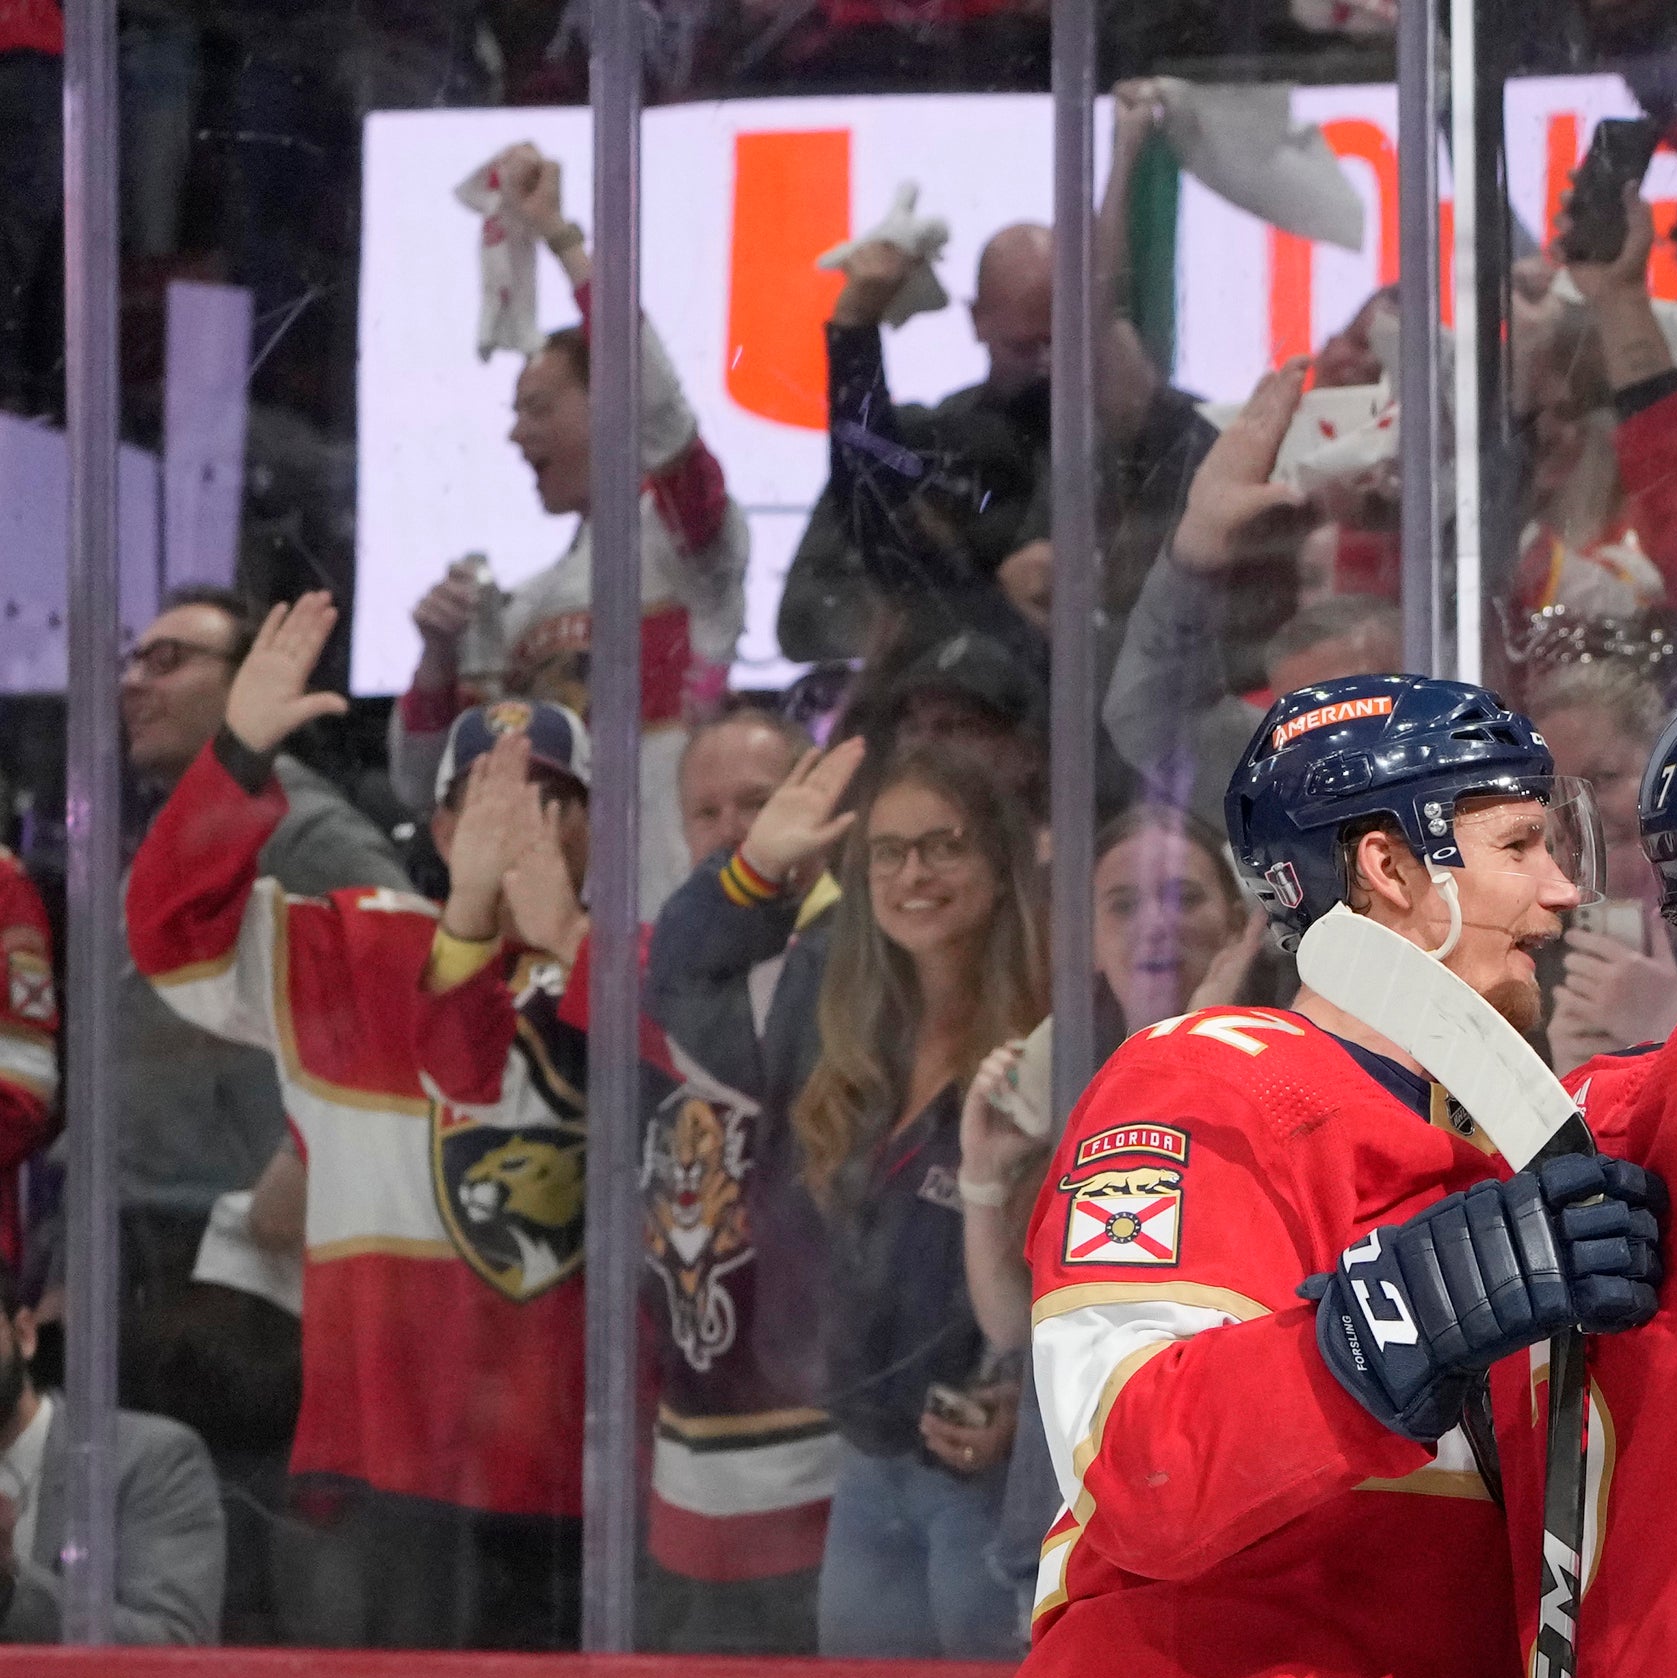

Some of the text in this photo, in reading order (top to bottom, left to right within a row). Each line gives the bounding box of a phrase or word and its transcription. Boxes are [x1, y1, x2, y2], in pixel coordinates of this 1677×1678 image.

[1273, 698, 1391, 747] AMERANT
[1656, 763, 1677, 810] 7
[1091, 1132, 1173, 1155] FLORIDA
[1342, 1315, 1368, 1372] FORSLING
